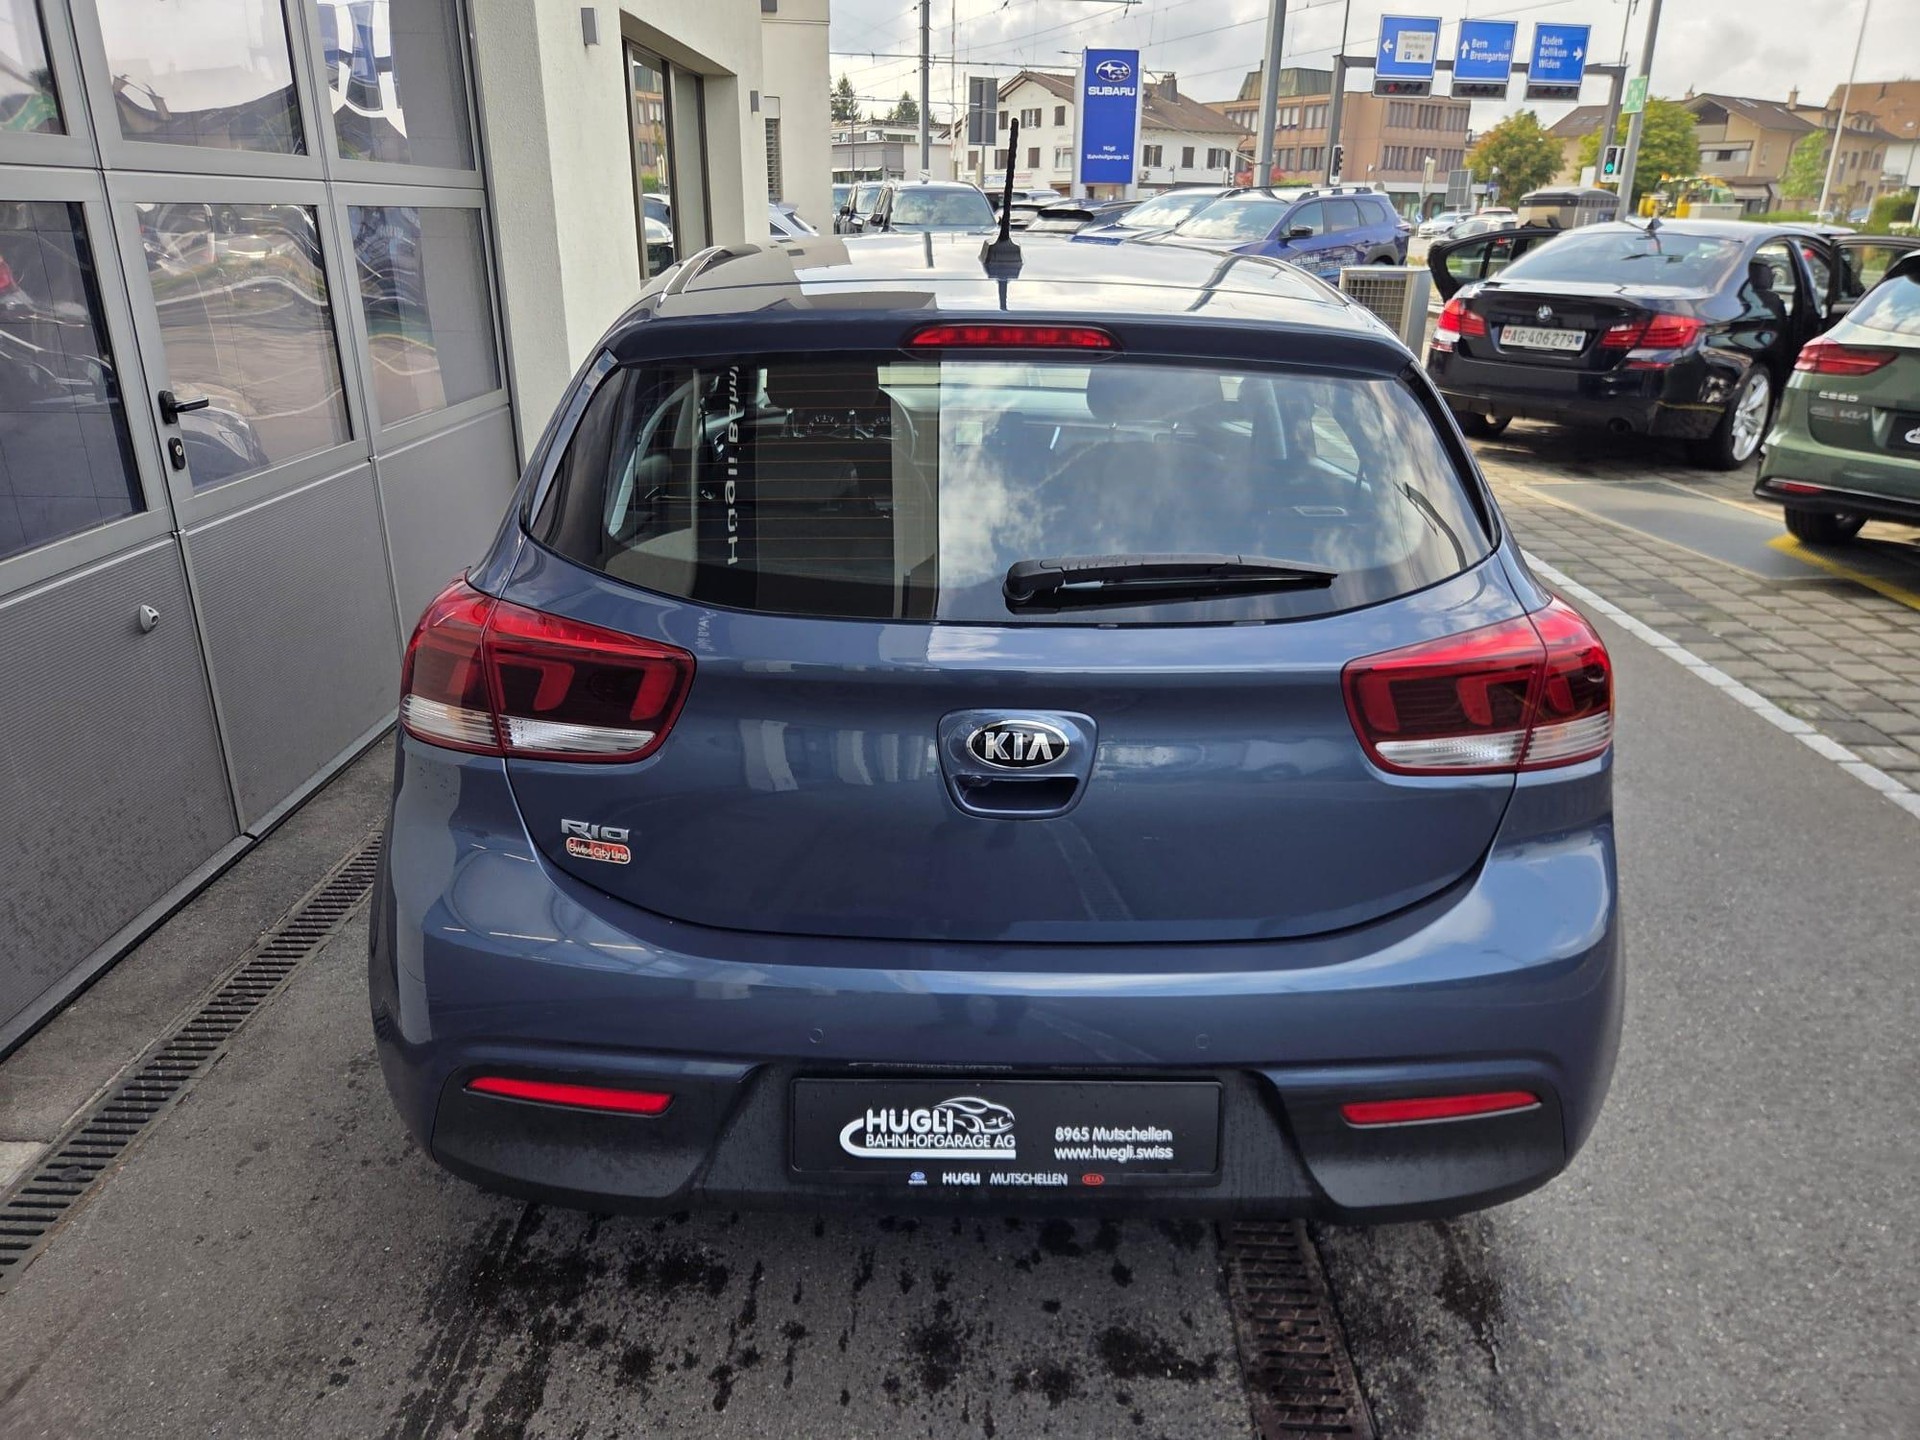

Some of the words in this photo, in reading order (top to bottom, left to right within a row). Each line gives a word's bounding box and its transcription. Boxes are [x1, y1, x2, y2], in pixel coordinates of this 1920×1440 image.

[1471, 38, 1488, 49] Bern
[1541, 35, 1563, 46] Baden
[1470, 50, 1510, 63] Bremgarten
[1538, 58, 1560, 69] Widen
[1088, 86, 1136, 96] SUBARU
[984, 731, 1053, 761] KIA
[561, 818, 630, 842] RIO
[866, 1133, 991, 1148] BAHNHOFGARAGE
[993, 1134, 1016, 1148] AG
[1054, 1126, 1090, 1142] 8965
[1091, 1125, 1173, 1142] Mutschellen
[1054, 1143, 1174, 1164] www.huegli.swiss
[989, 1172, 1068, 1186] MUTSCHELLEN
